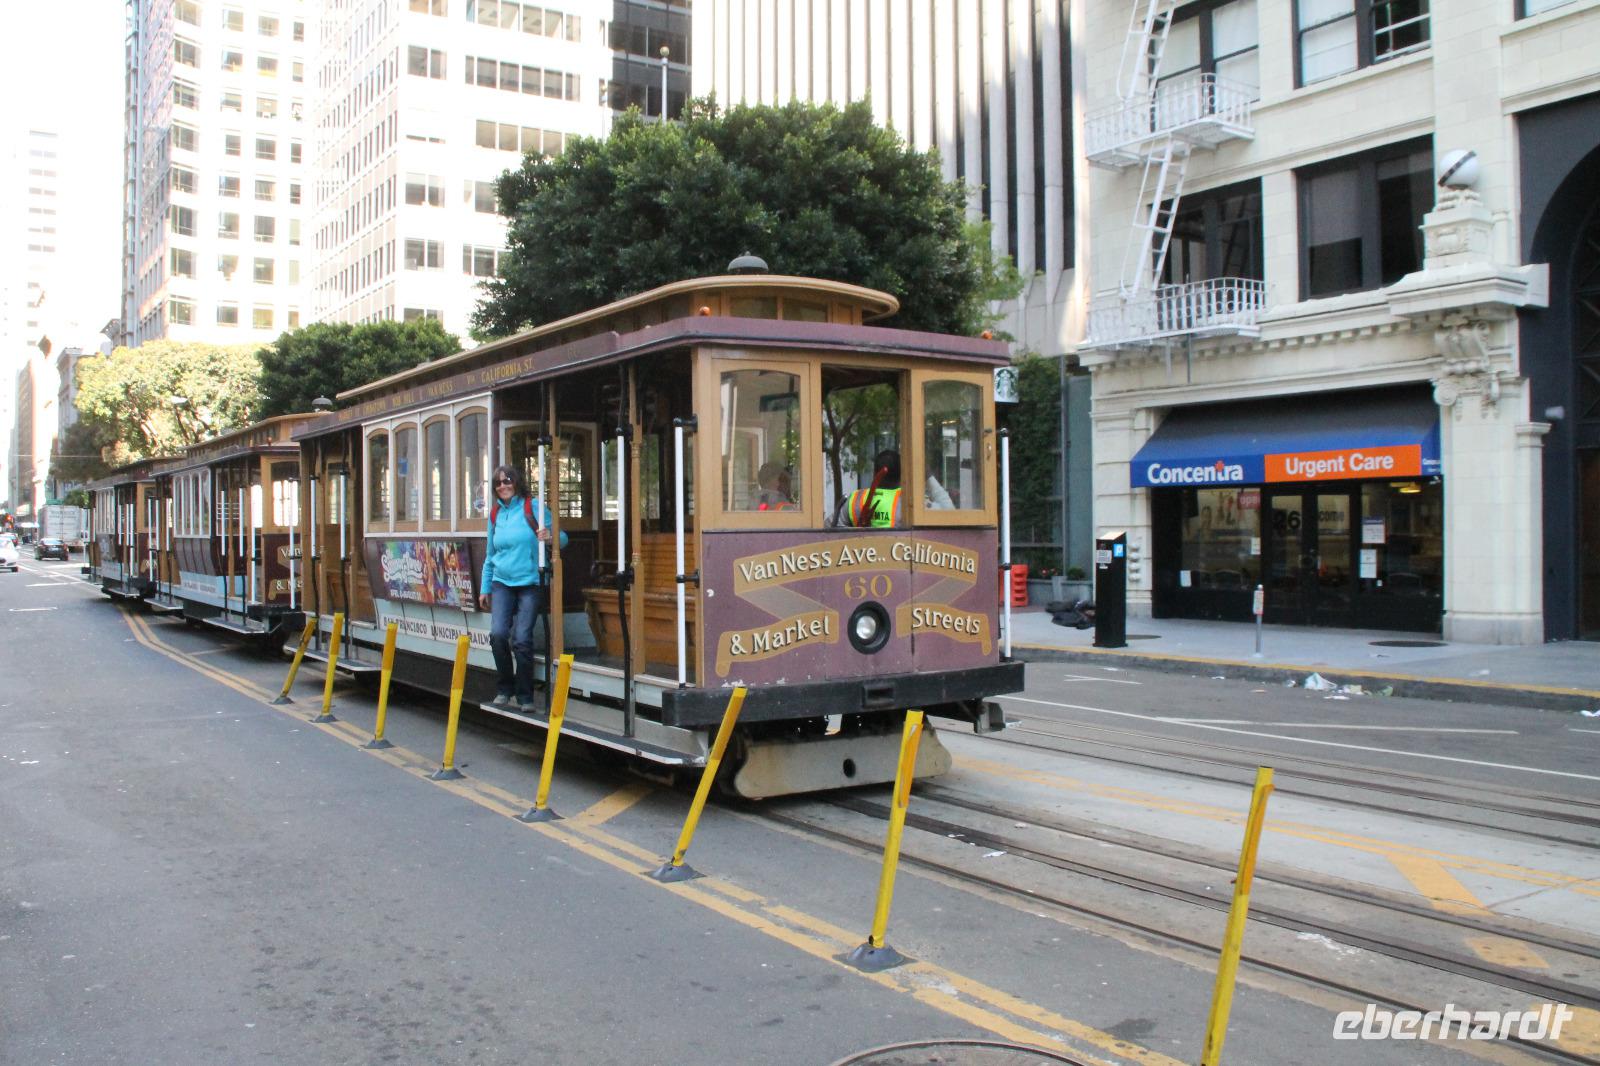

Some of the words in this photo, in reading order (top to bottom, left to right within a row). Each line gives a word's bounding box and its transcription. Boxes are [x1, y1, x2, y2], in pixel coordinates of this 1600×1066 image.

[481, 361, 522, 383] CALIFORNIA
[1147, 460, 1243, 484] Concentra
[1285, 456, 1344, 478] Urgent
[1349, 453, 1394, 472] Care
[739, 560, 778, 583] Van
[781, 549, 832, 575] Ness
[892, 541, 976, 576] California
[844, 574, 893, 600] 60
[912, 606, 981, 635] Streets
[467, 631, 491, 646] RAILW
[730, 632, 747, 656] &
[752, 616, 830, 652] Market
